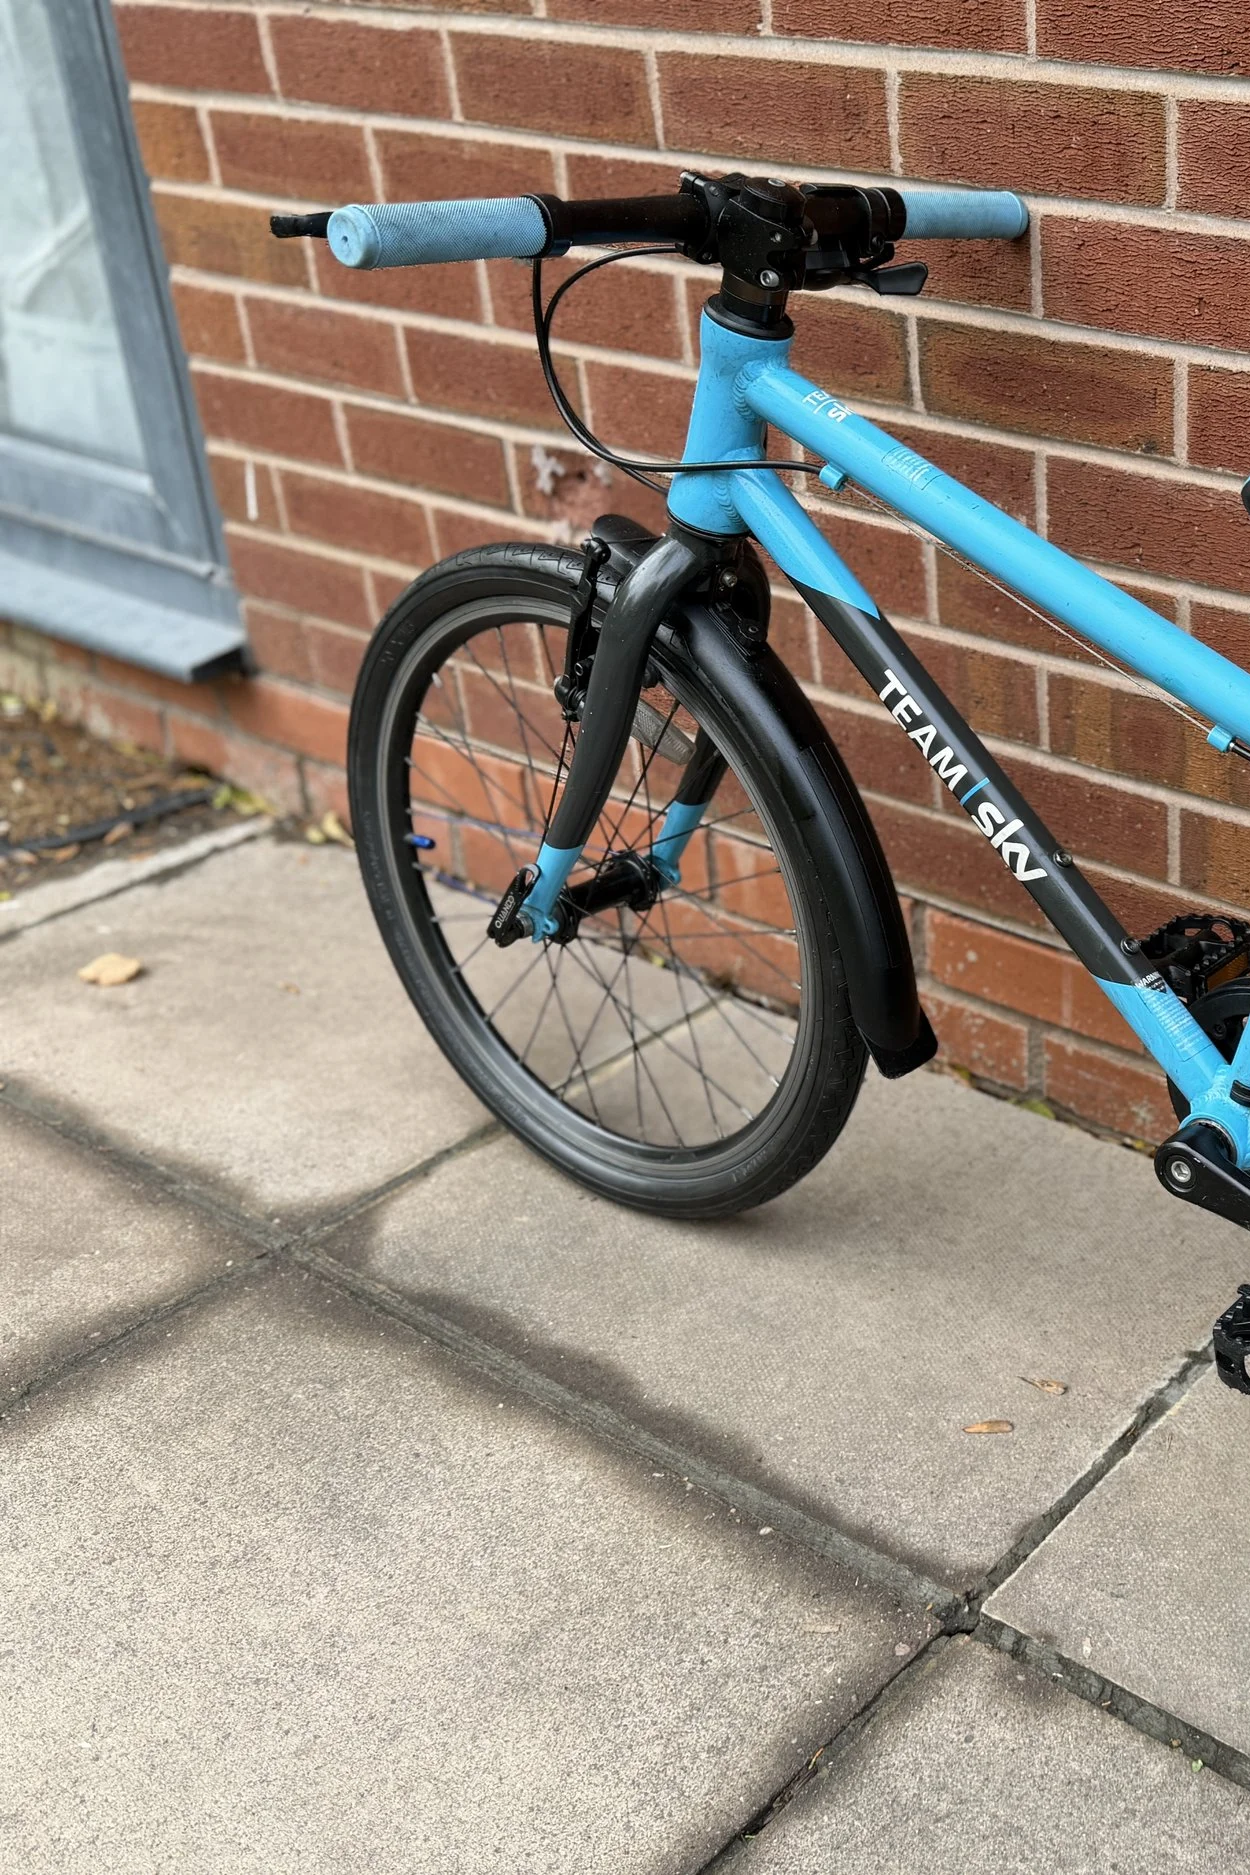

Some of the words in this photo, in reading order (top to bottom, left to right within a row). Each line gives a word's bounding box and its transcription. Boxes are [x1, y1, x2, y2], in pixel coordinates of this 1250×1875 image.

[878, 668, 969, 792] TEAM
[971, 801, 1048, 882] sky
[494, 895, 515, 929] QUANDO
